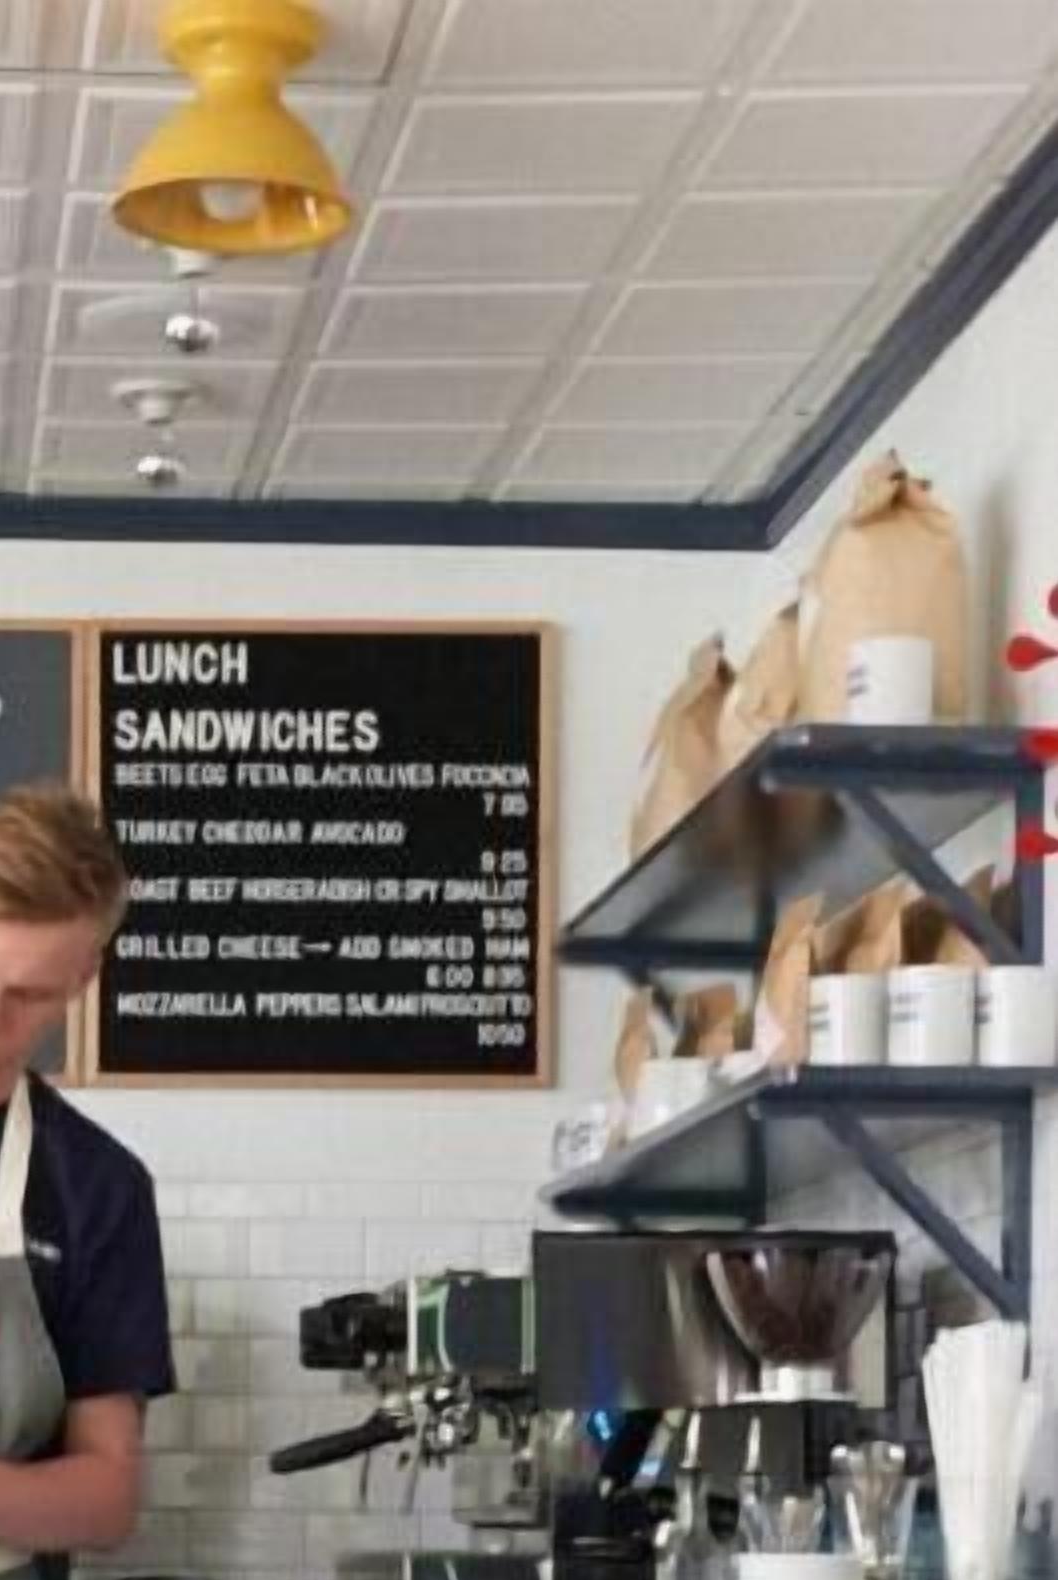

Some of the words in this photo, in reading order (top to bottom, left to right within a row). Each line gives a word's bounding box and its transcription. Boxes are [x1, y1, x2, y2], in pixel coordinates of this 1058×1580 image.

[112, 641, 248, 685] LUNCH
[113, 709, 380, 752] SANDWICHES
[115, 820, 197, 844] TURKEY
[202, 820, 303, 845] CHEDDAR
[310, 820, 406, 845] AVOCADO
[128, 878, 180, 902] OAST
[116, 935, 210, 960] GRILLED
[117, 992, 246, 1017] MOZZARELLA
